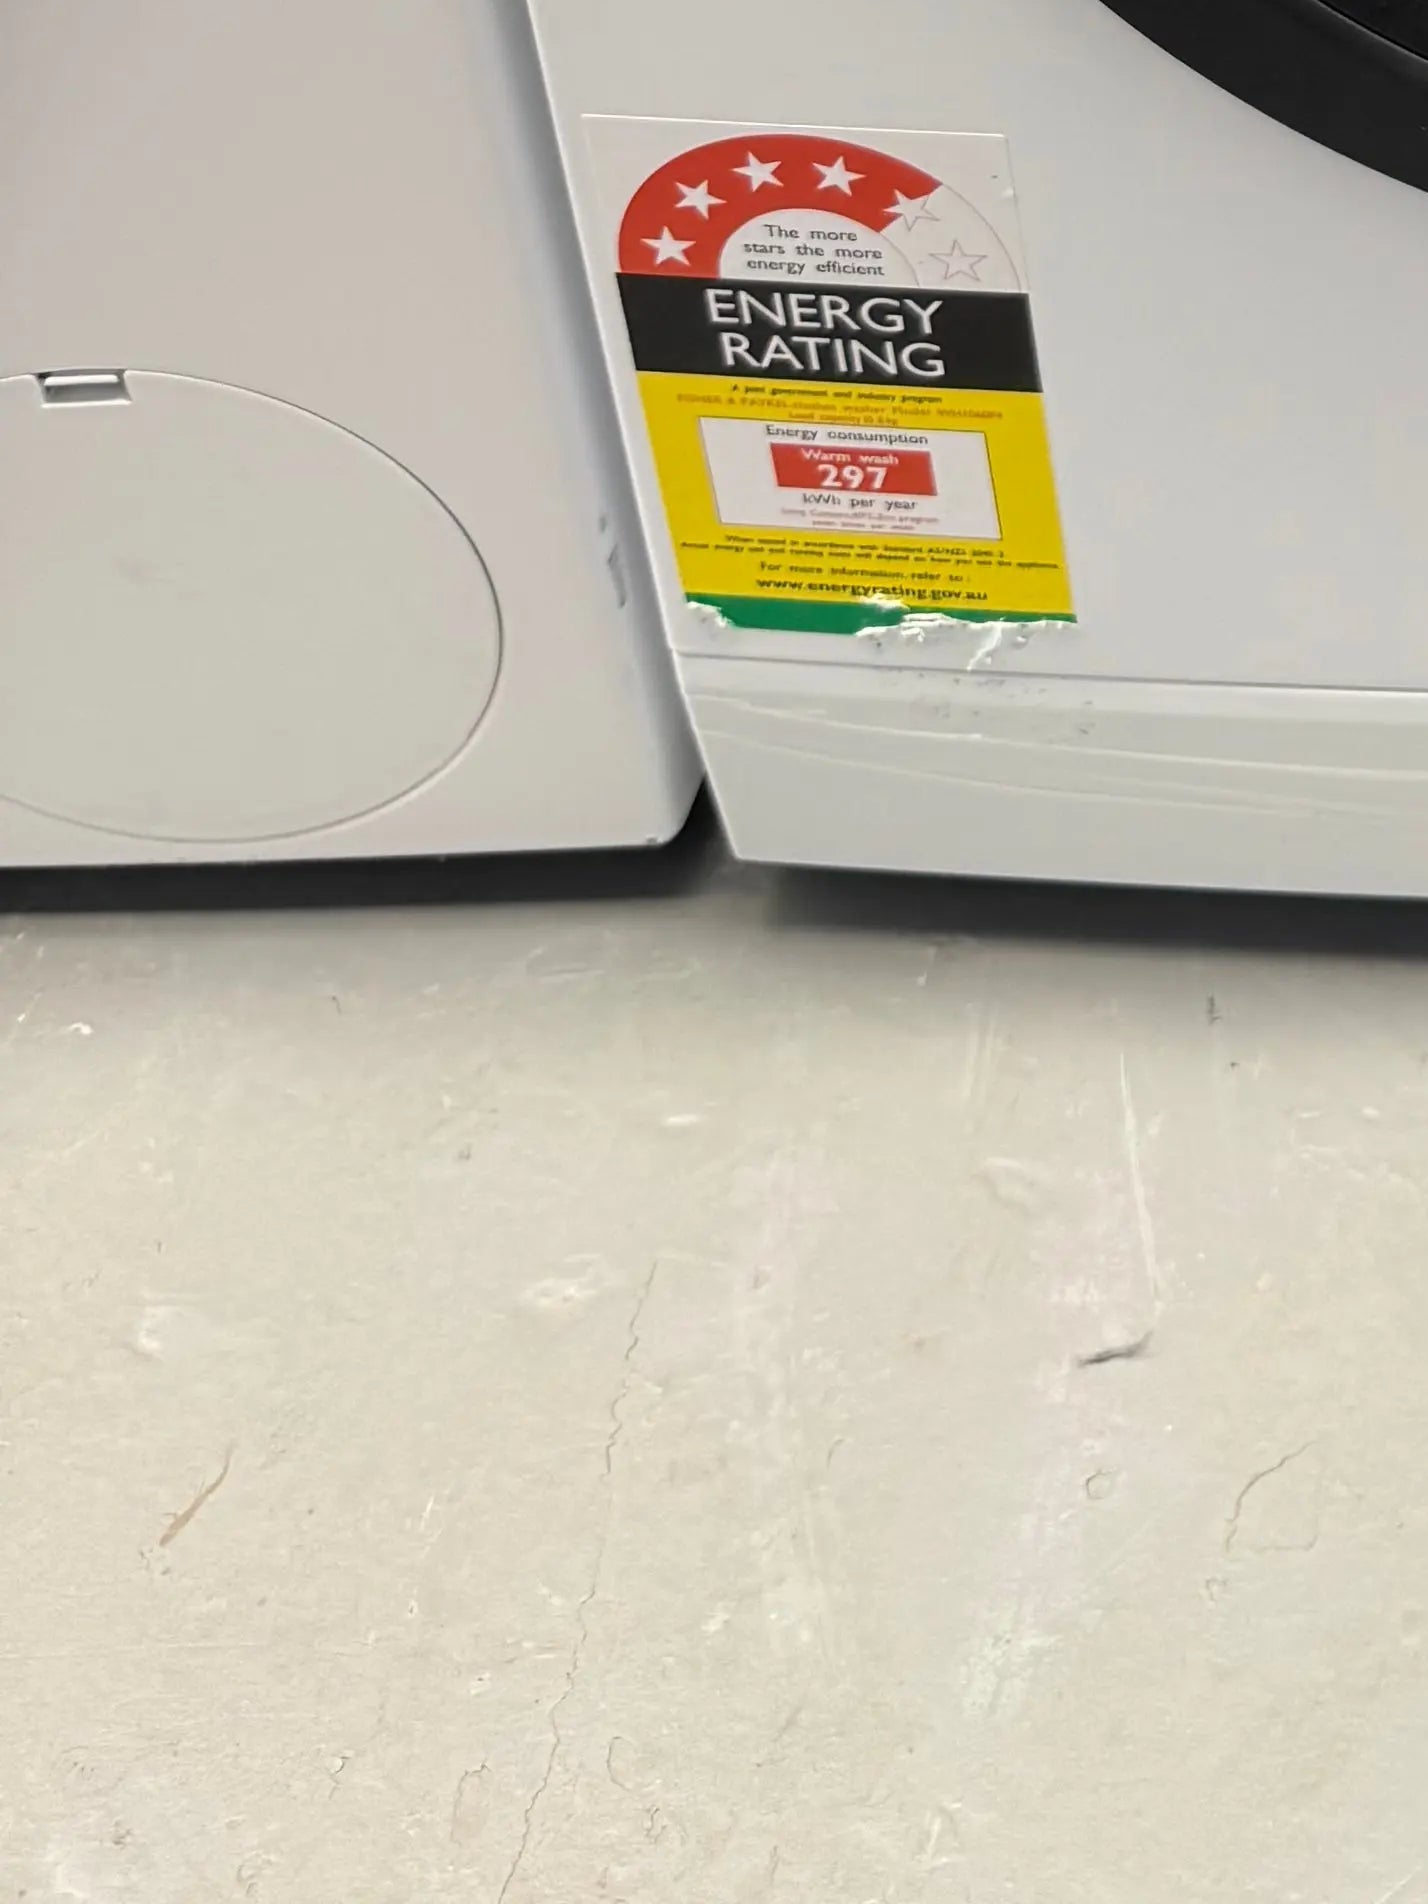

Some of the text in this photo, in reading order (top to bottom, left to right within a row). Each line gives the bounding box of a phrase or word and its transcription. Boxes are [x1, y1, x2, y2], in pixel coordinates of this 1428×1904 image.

[763, 223, 858, 242] The more
[743, 243, 883, 259] stars the more
[746, 258, 884, 275] energy efficient
[704, 287, 943, 335] ENERGY
[721, 332, 946, 378] RATING
[765, 424, 929, 446] Energy consumption
[800, 448, 899, 466] Warm wash
[817, 463, 888, 490] 297
[802, 492, 918, 511] kWh per year
